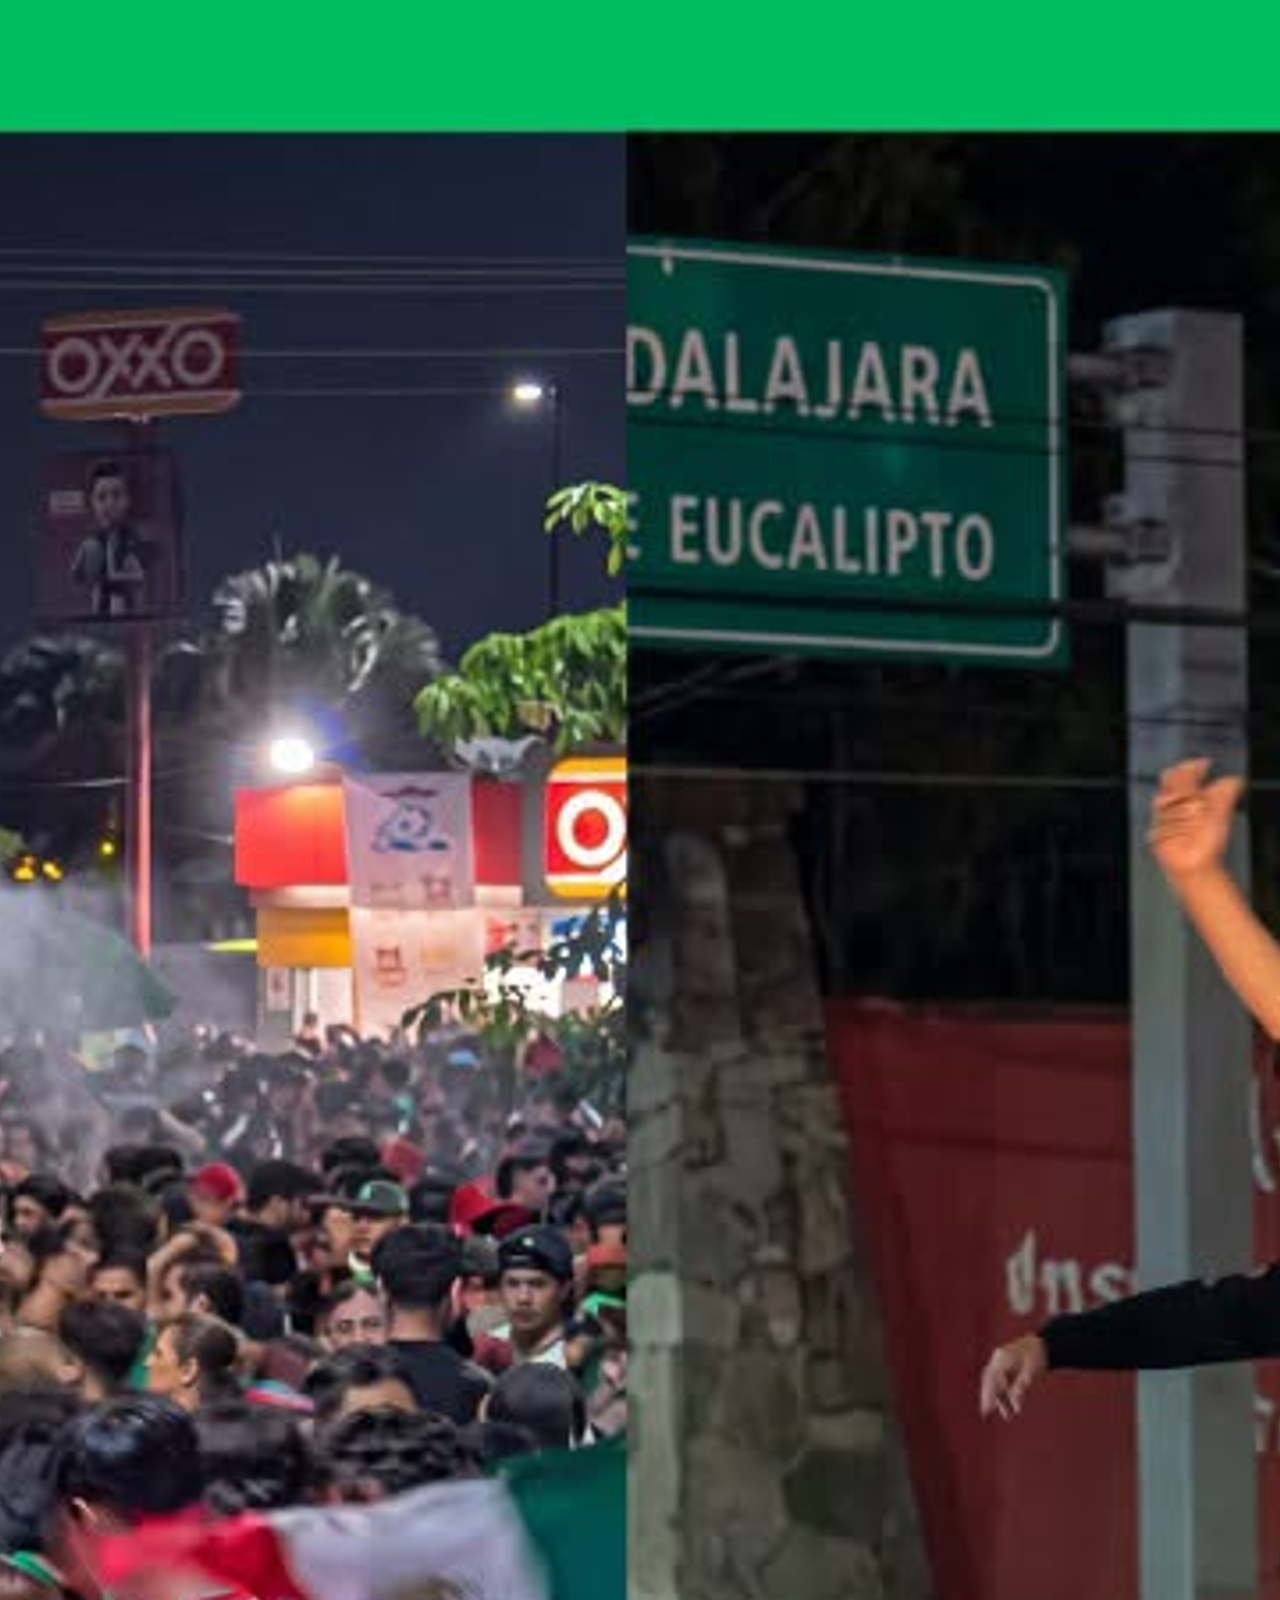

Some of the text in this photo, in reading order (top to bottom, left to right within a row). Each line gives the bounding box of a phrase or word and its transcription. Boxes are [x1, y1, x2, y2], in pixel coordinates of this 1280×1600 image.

[49, 324, 224, 398] OXXO
[670, 495, 995, 582] EUCALIPTO
[557, 789, 627, 880] O
